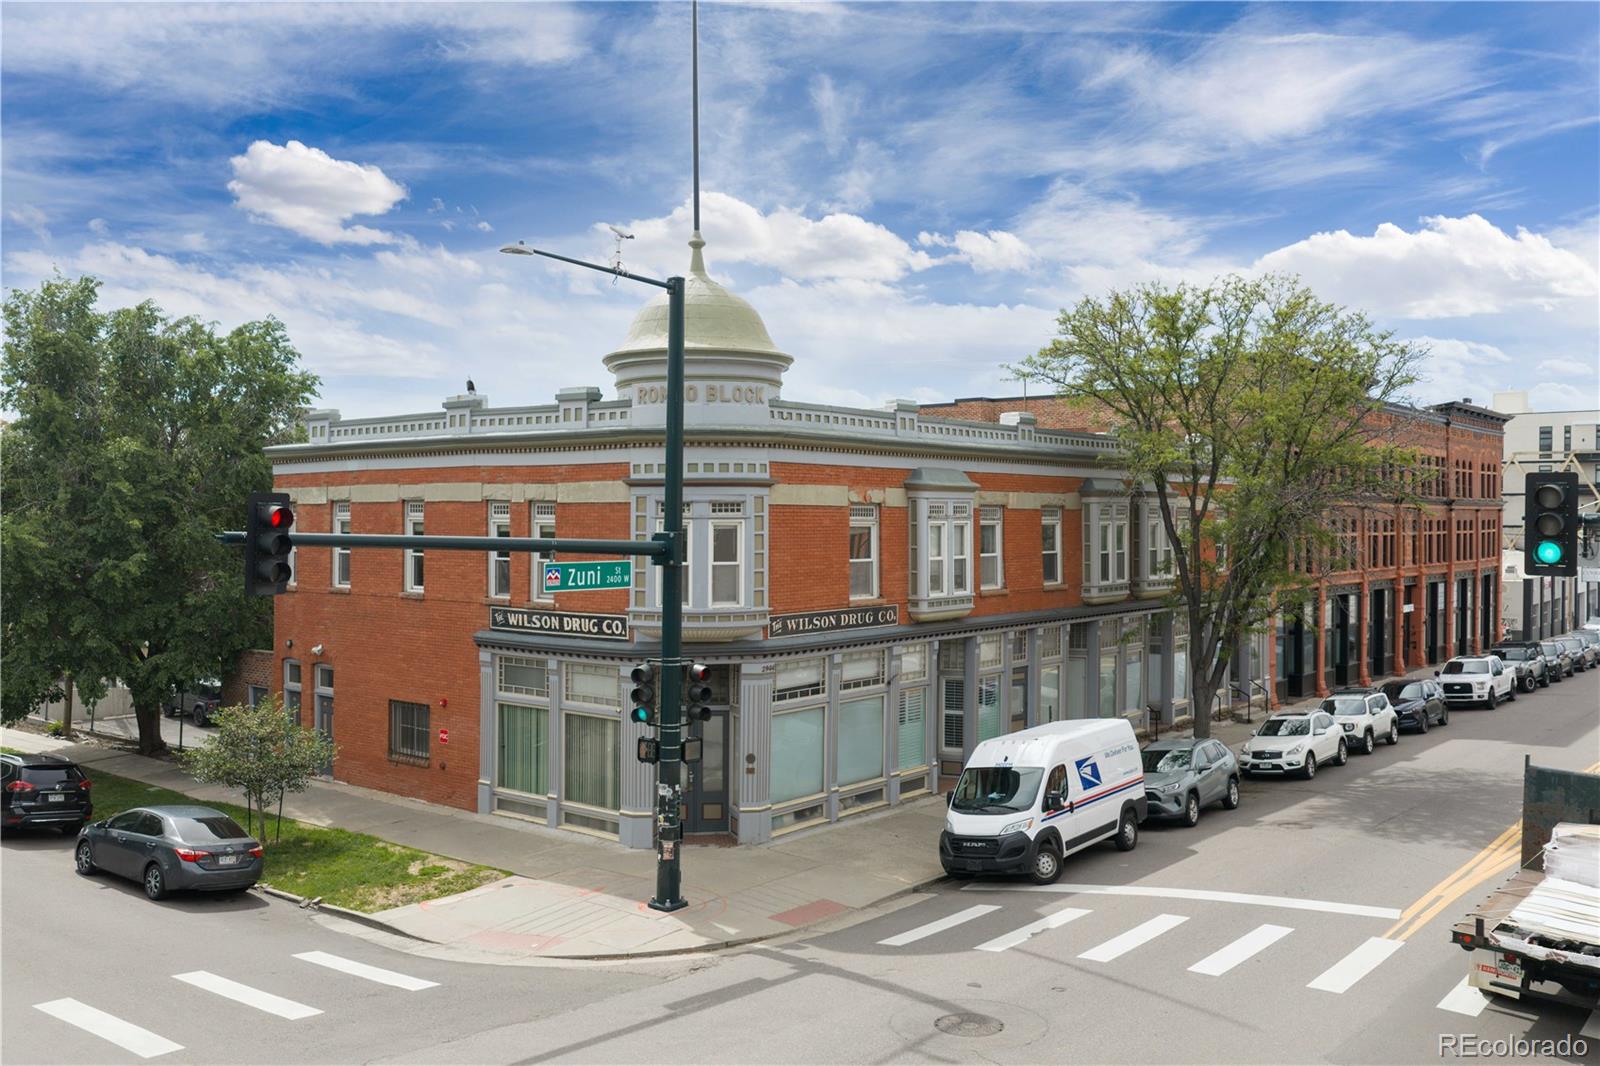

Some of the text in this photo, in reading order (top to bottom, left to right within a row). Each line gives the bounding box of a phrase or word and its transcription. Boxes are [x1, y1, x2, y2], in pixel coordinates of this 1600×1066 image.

[705, 384, 765, 404] BLOCK
[567, 566, 601, 586] Zuni
[614, 566, 622, 575] St
[606, 574, 630, 584] 2400 W
[507, 612, 560, 630] WILSON
[563, 616, 598, 632] DRUG
[602, 619, 626, 635] CO.
[787, 615, 836, 633] WILSON
[841, 611, 874, 626] DRUG
[878, 609, 897, 622] CO.
